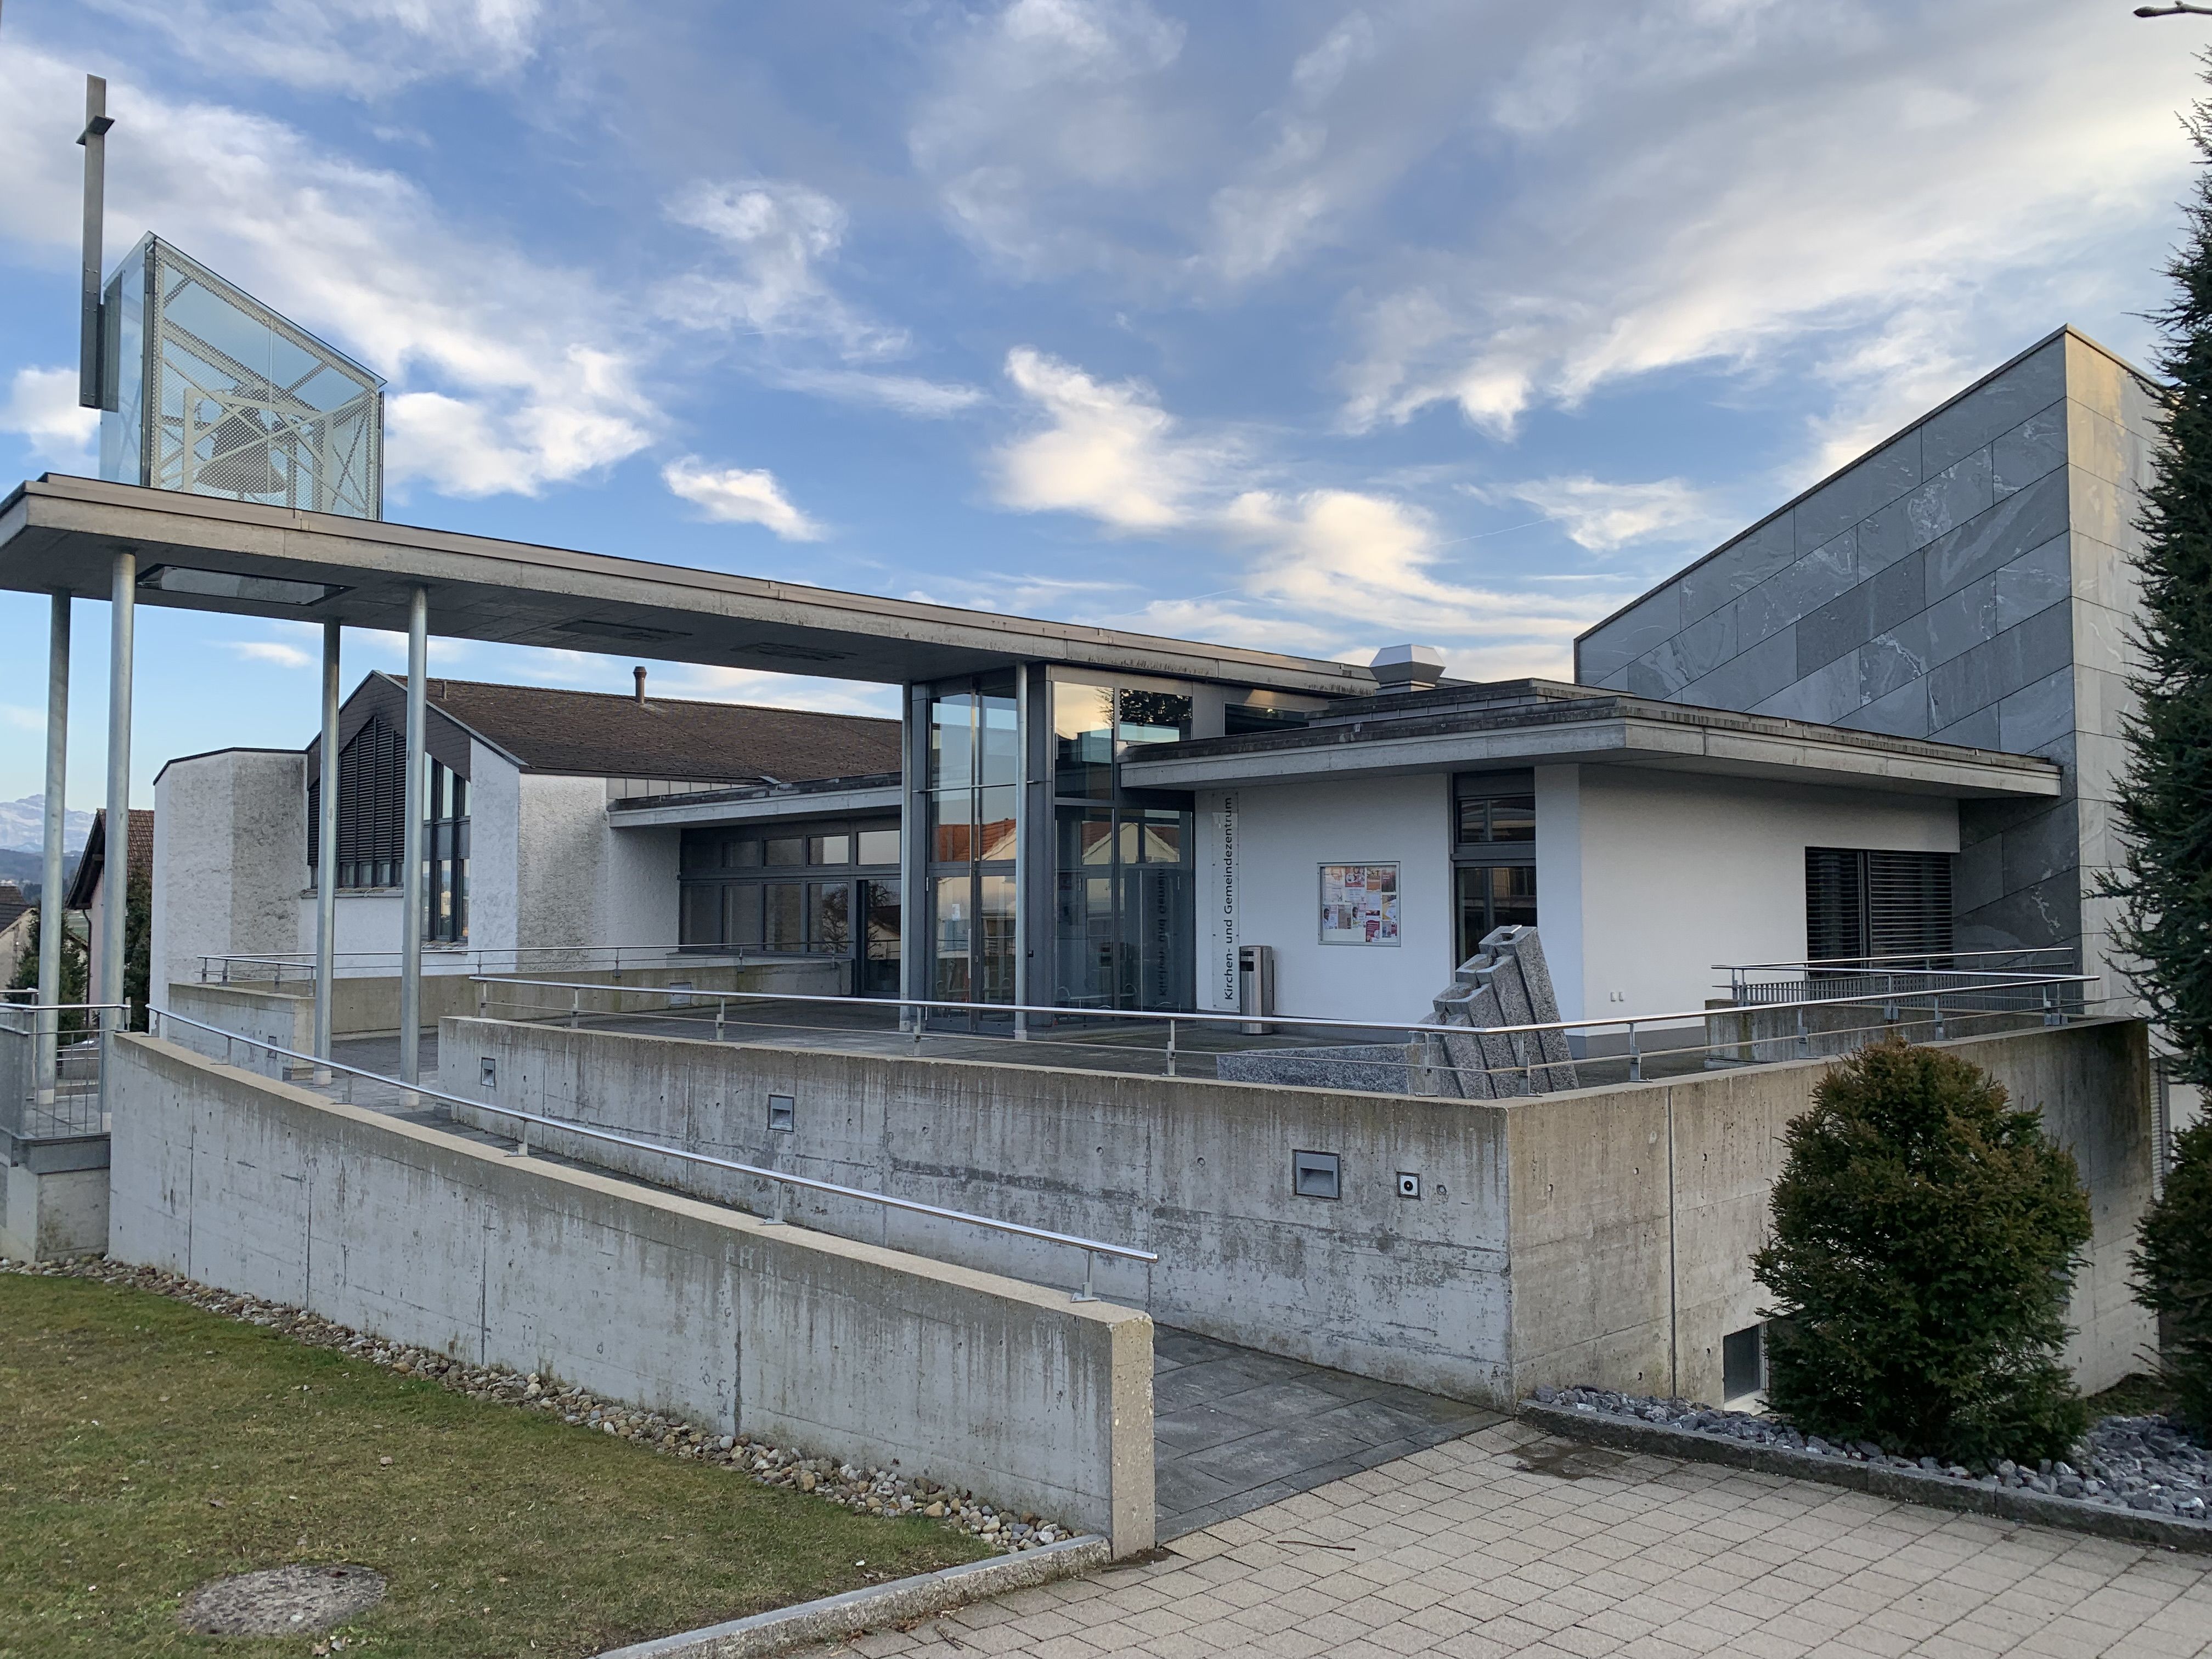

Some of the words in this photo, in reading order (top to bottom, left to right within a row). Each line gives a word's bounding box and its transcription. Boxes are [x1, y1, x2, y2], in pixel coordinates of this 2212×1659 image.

[1224, 798, 1232, 914] Gemeindezentrum
[1224, 919, 1232, 943] und
[1224, 949, 1233, 1000] Kirchen-
